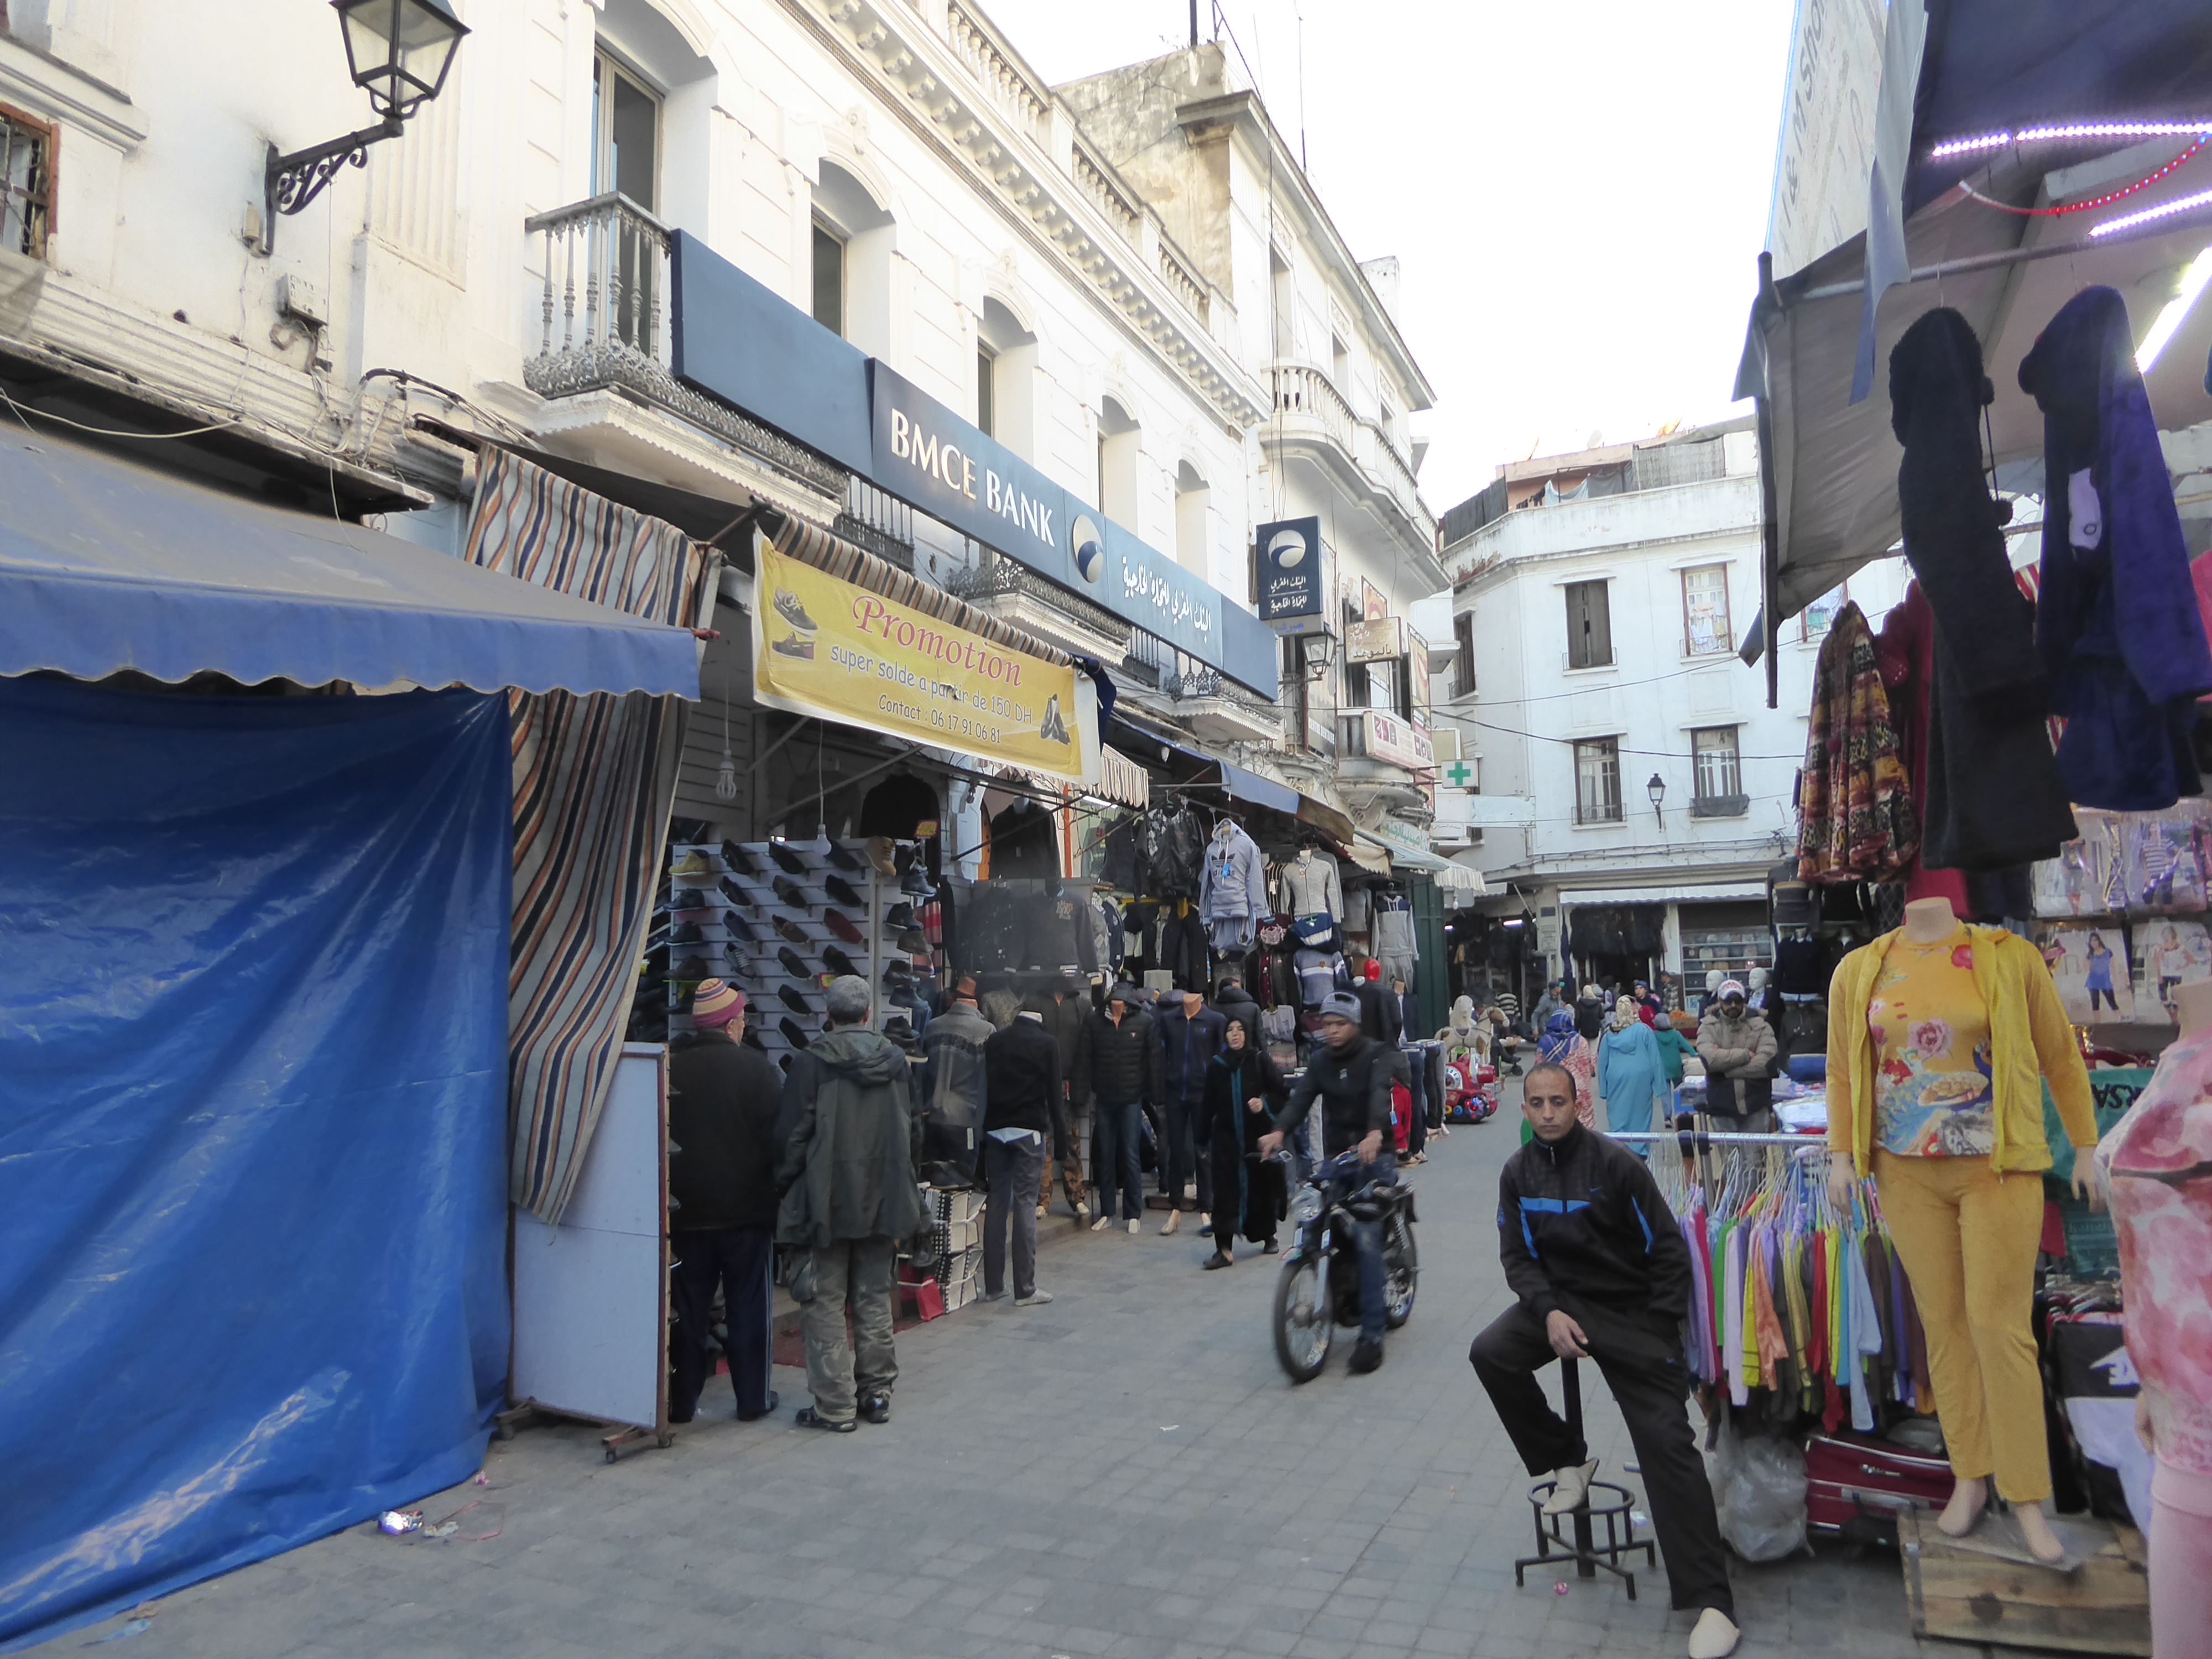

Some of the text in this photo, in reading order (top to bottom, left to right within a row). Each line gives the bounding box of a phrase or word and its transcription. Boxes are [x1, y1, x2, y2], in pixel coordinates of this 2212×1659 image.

[891, 408, 1055, 547] BMCE BANK
[1122, 556, 1148, 598] الخارجية
[1271, 576, 1306, 593] البنك المغربي
[1171, 589, 1192, 626] المغربي
[1194, 602, 1211, 644] البنك
[1271, 597, 1290, 613] الخارجية
[852, 594, 1022, 687] Promotion
[831, 644, 873, 675] super
[877, 659, 915, 687] solde
[972, 687, 987, 712] de
[990, 695, 1013, 719] 150
[1015, 705, 1033, 725] DH
[879, 693, 921, 722] Contact
[930, 708, 945, 728] 06
[948, 713, 958, 732] 17
[962, 718, 973, 736] 91
[975, 722, 988, 740] 06
[990, 727, 1001, 744] 81
